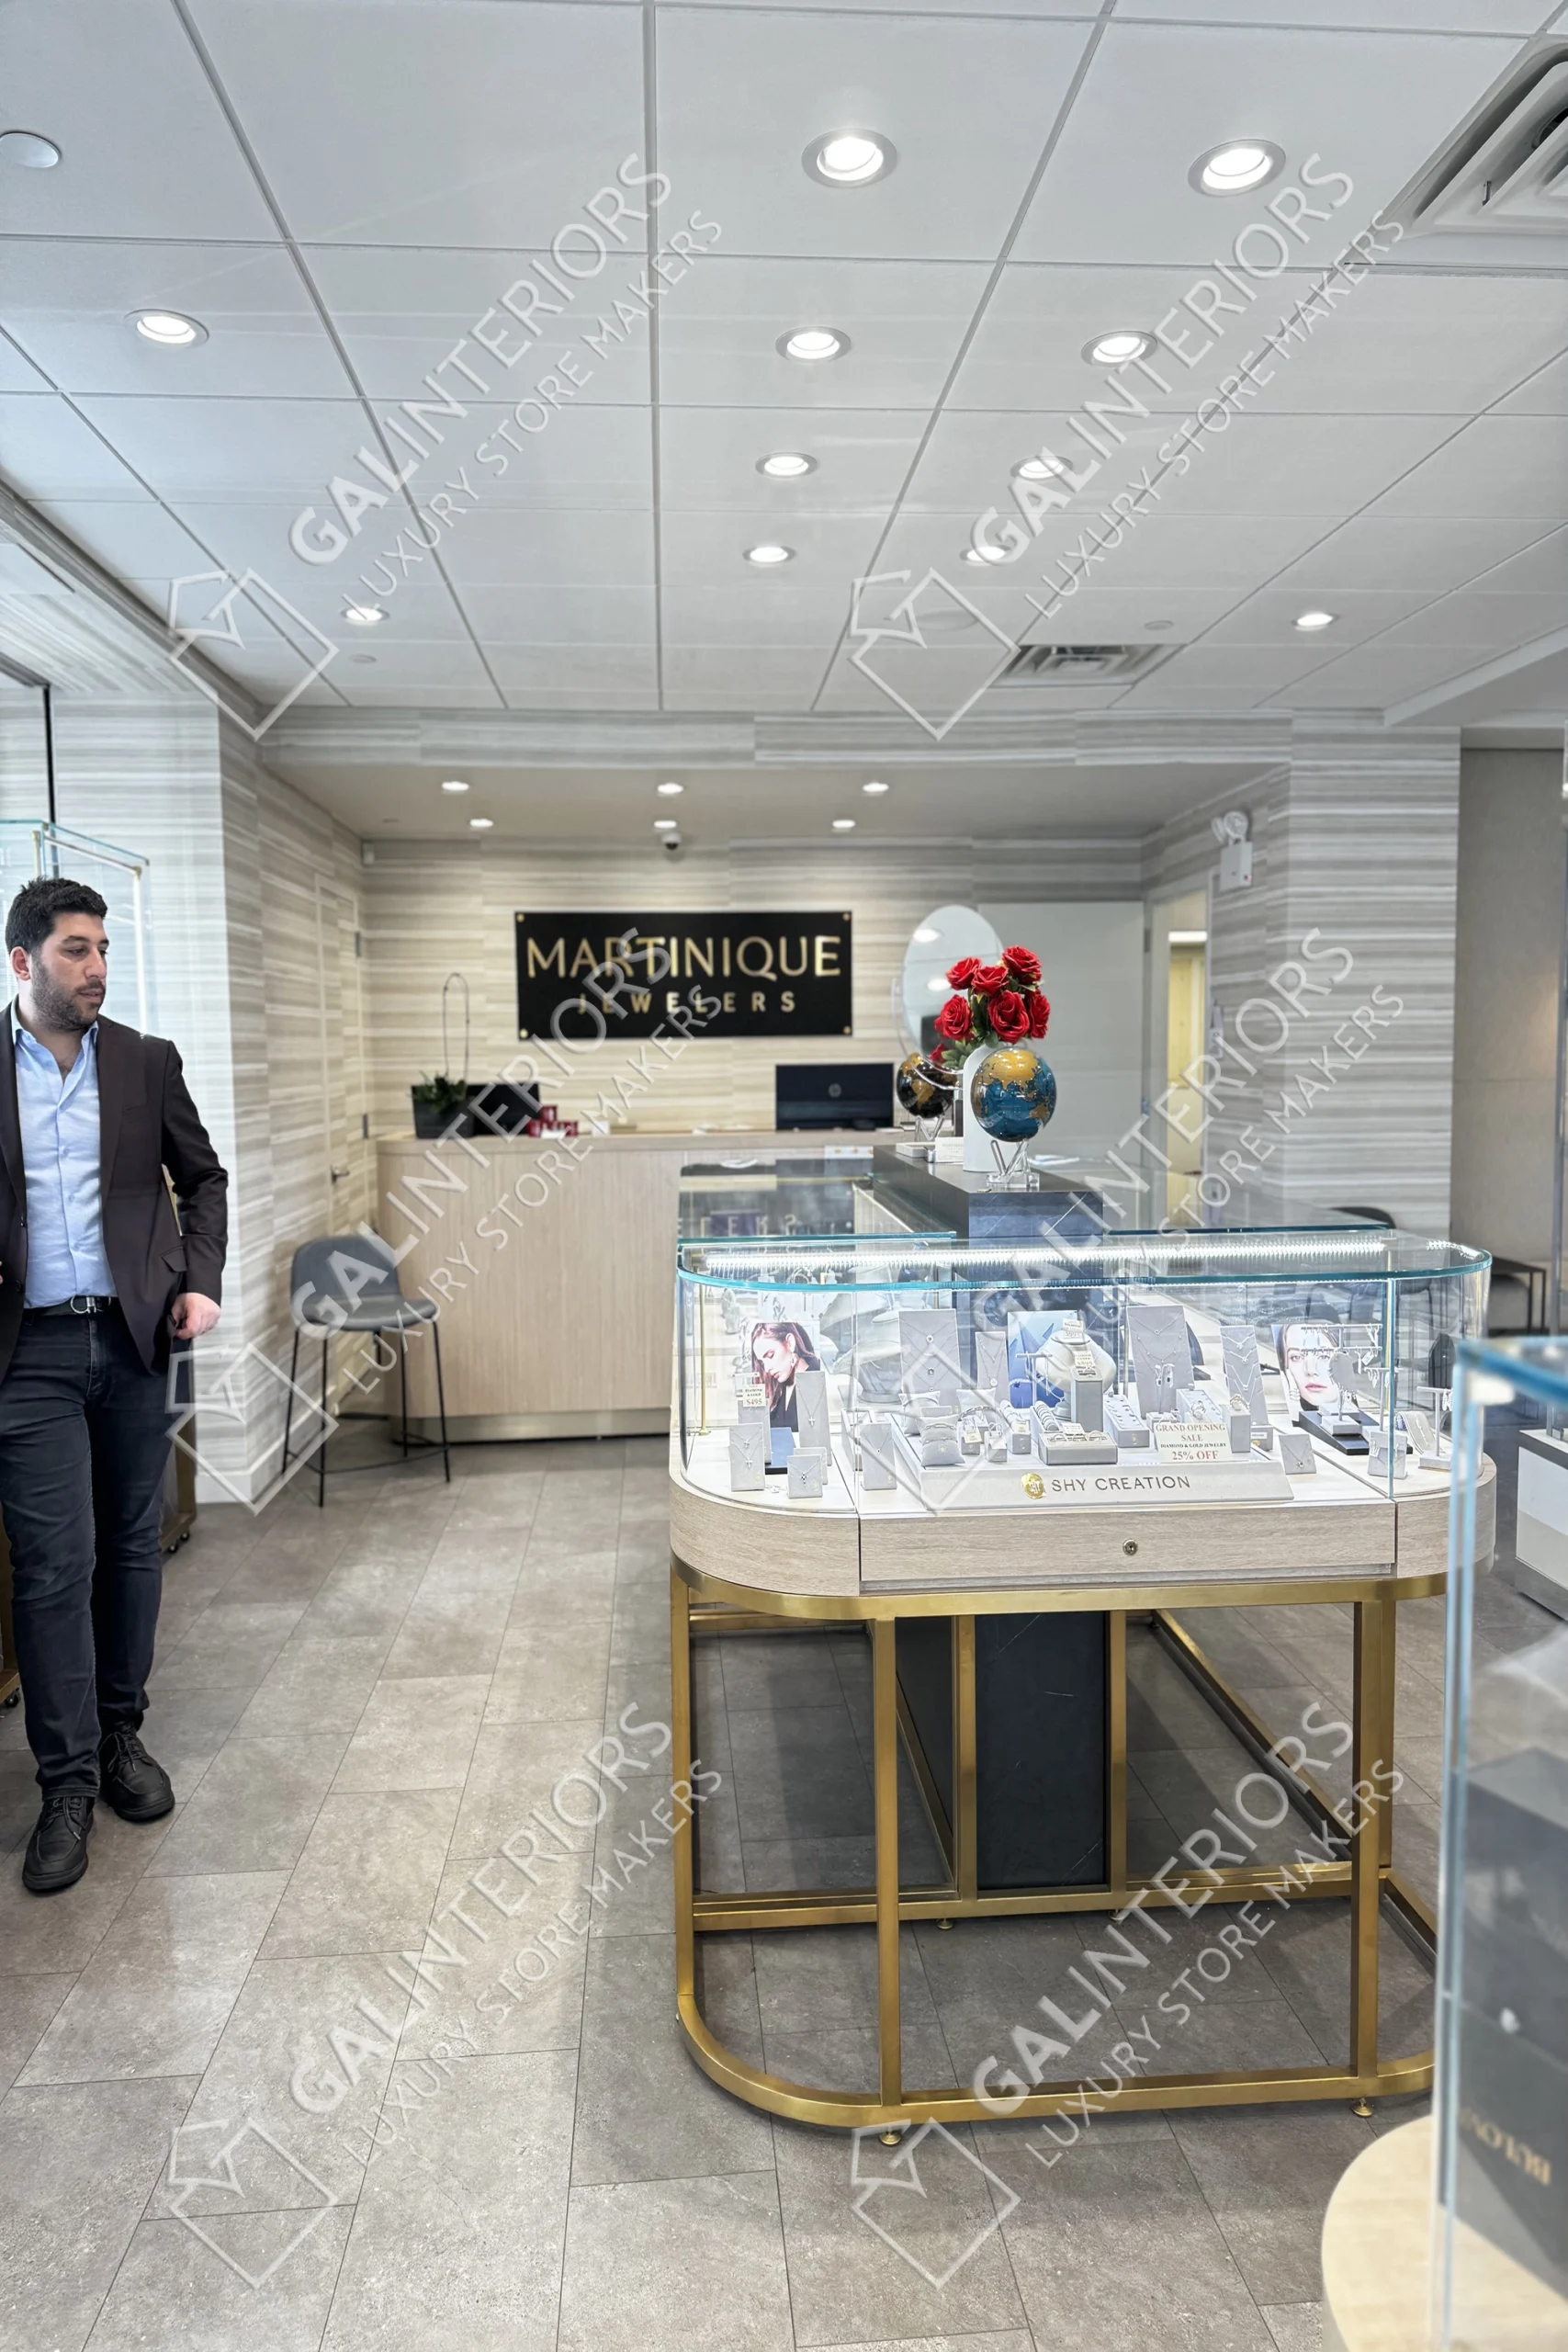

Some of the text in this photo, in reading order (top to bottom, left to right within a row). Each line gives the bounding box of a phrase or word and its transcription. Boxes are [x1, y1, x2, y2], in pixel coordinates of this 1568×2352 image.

[527, 935, 840, 981] MARTINIQUE
[578, 991, 795, 1014] JEWELERS
[1156, 1423, 1225, 1432] GRAND OPENING
[1172, 1451, 1218, 1460] 25% OFF
[1051, 1478, 1087, 1492] SHY
[1095, 1476, 1190, 1491] CREATION
